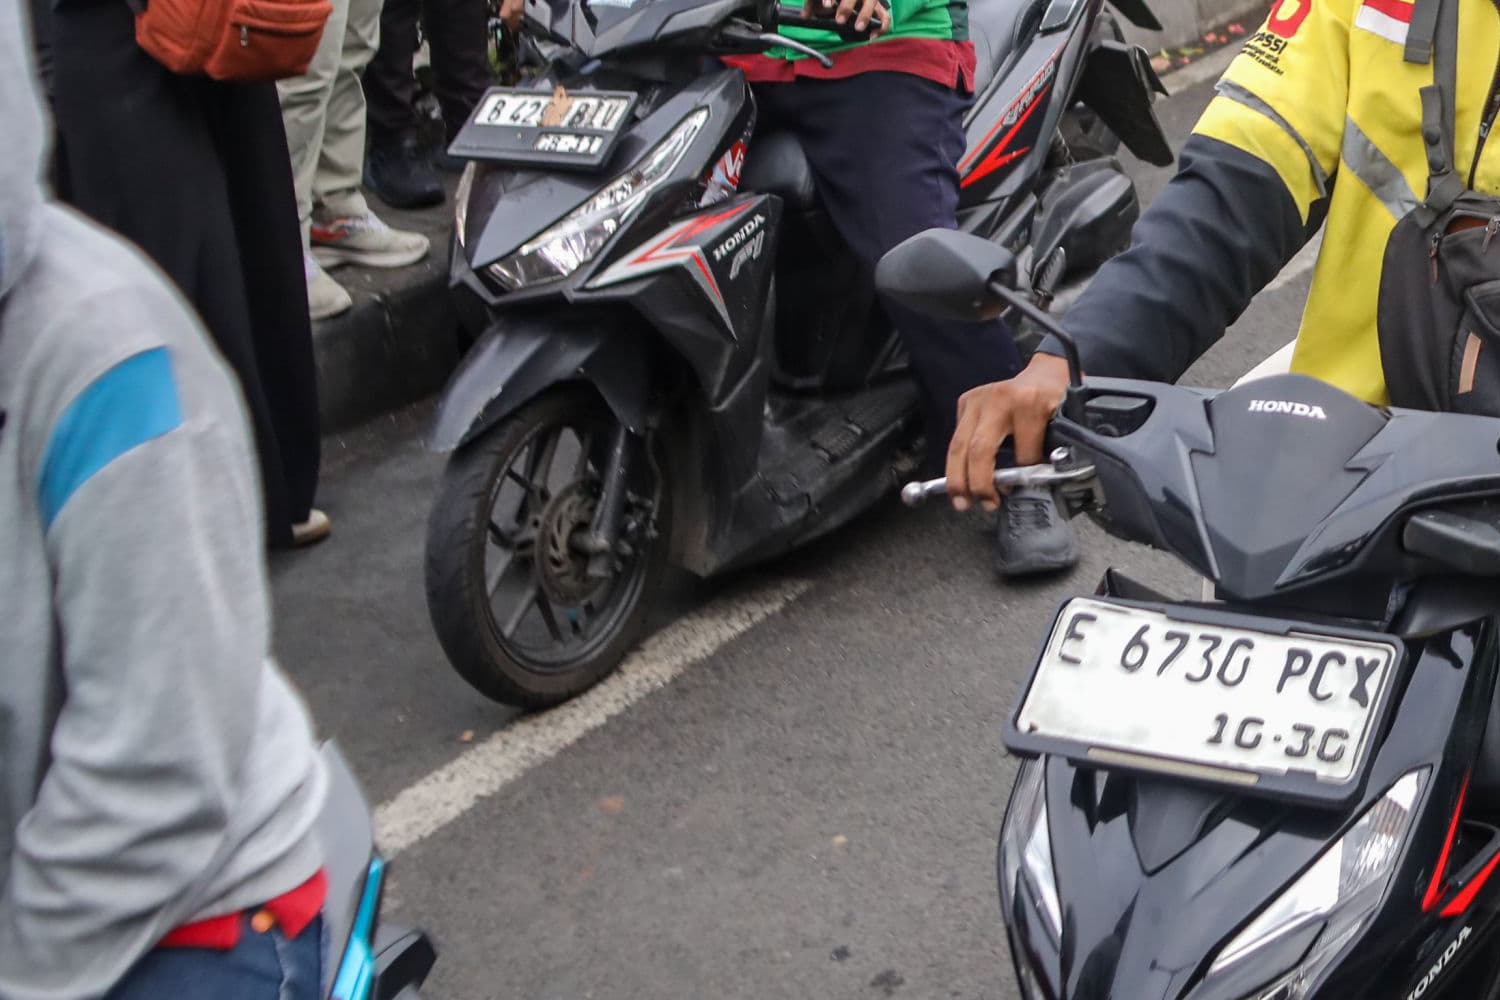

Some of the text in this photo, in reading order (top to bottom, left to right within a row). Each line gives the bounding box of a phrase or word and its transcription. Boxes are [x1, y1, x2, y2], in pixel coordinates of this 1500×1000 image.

[487, 99, 507, 123] B
[712, 213, 766, 262] HONDA
[1247, 399, 1327, 420] HONDA
[1059, 611, 1098, 666] E
[1275, 646, 1381, 709] PCX
